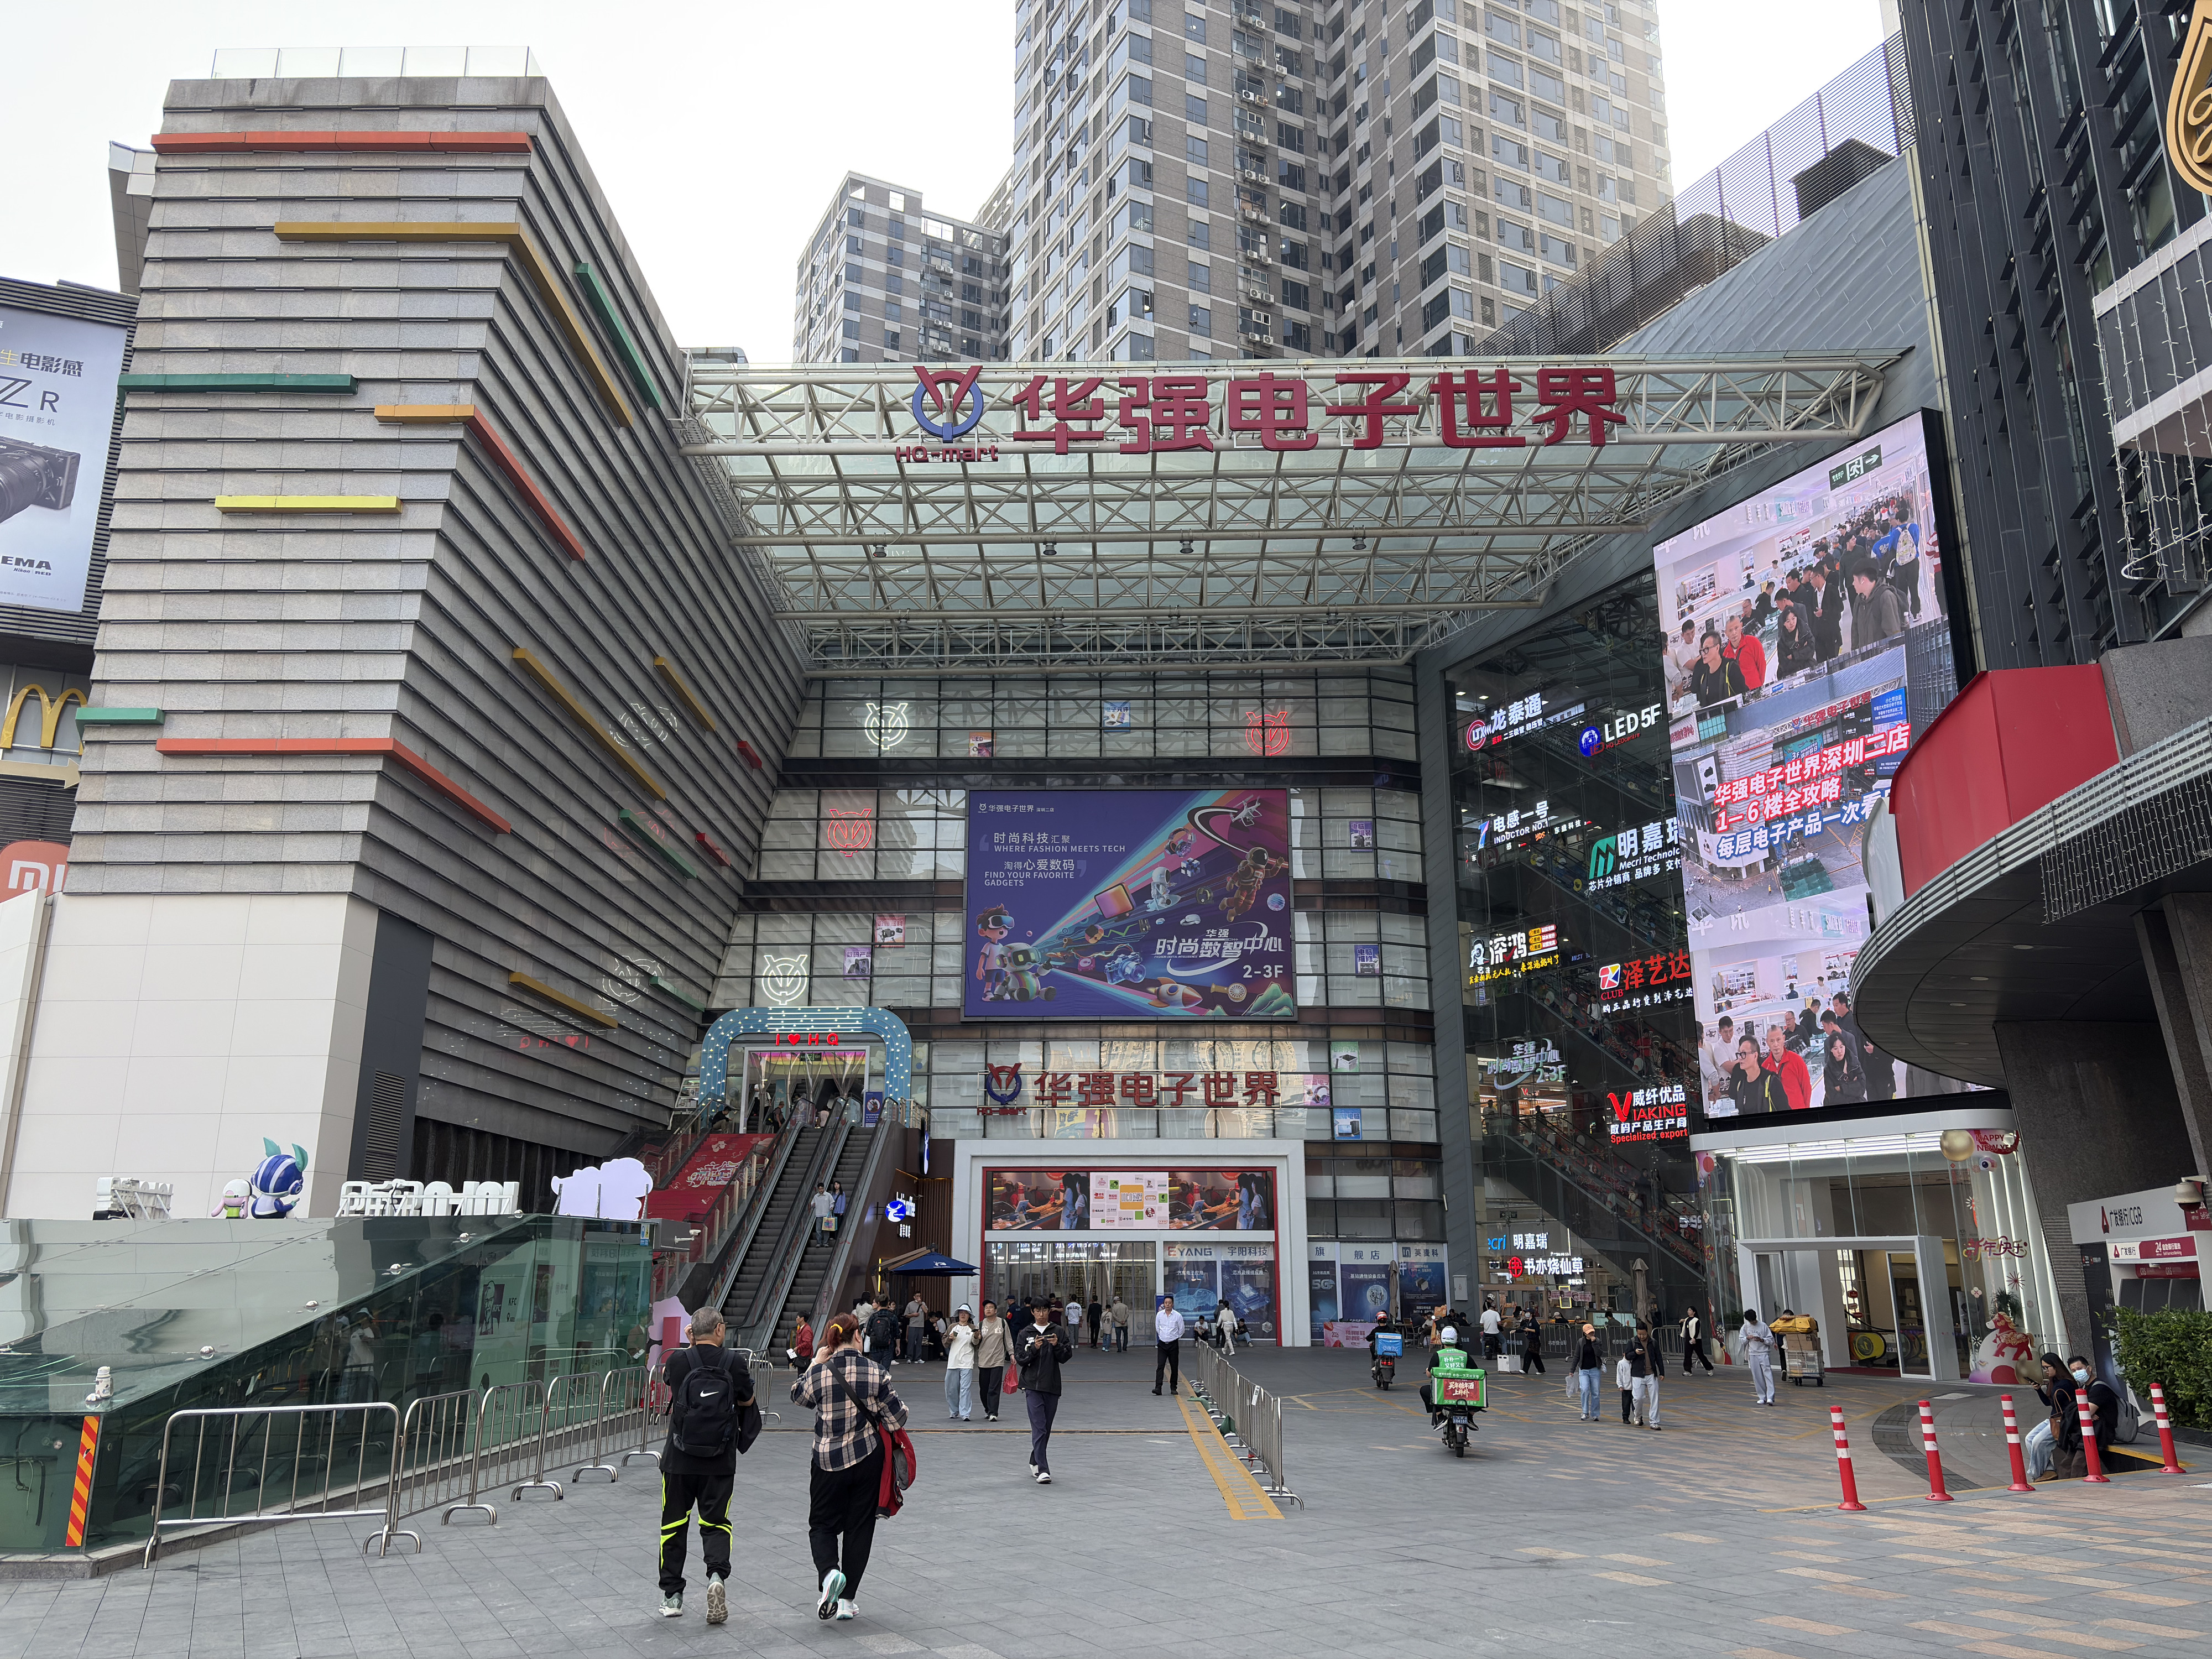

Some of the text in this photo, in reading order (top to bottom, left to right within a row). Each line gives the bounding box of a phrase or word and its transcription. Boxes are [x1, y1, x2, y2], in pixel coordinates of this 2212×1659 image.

[40, 390, 60, 413] R
[0, 411, 55, 426] 电影摄影机
[1013, 367, 1626, 455] 华强电子世界
[896, 445, 998, 462] HQ-mart
[1491, 692, 1542, 733] 龙泰通
[1605, 713, 1639, 742] LED
[1641, 703, 1661, 728] 5F
[1715, 725, 1911, 806] 华强电子世界深圳二店
[1494, 800, 1548, 832] 电感一号
[1717, 788, 1891, 858] 每层电子产品一次看
[1494, 827, 1530, 844] INDUCTOR
[1619, 857, 1642, 871] Mecri
[1588, 871, 1630, 891] 芯片分销商
[1635, 863, 1661, 880] 品牌多
[1206, 928, 1229, 938] 华强
[1151, 932, 1285, 958] 时尚数智中心
[1489, 932, 1527, 965] 深鸿
[1243, 964, 1284, 978] 2-3F
[1623, 948, 1691, 990] 泽艺达
[1601, 989, 1624, 1000] CLUB
[1512, 1041, 1536, 1056] 华强
[1487, 1047, 1562, 1075] 时尚数智中心
[1536, 1064, 1567, 1083] 2-3F
[1035, 1072, 1281, 1107] 华强电子世界
[1632, 1084, 1686, 1107] 威纤优品
[1610, 1117, 1687, 1135] 数码产品生产商
[1610, 1128, 1688, 1145] Specialized export
[2109, 1206, 2143, 1228] 广发银行 CGB
[1513, 1232, 1548, 1250] 明嘉瑞
[1963, 1235, 2028, 1262] 新年快乐
[2155, 1241, 2162, 1253] 24
[1167, 1246, 1268, 1256] EYANG 宇阳科技
[1315, 1247, 1325, 1256] 旗
[1415, 1249, 1438, 1257] 英麦科
[2121, 1246, 2136, 1255] 广发银行
[1524, 1256, 1584, 1275] 书亦烧仙草
[1312, 1279, 1335, 1290] 5G
[508, 1297, 517, 1306] KFC
[1452, 1389, 1469, 1397] 上朴朴
